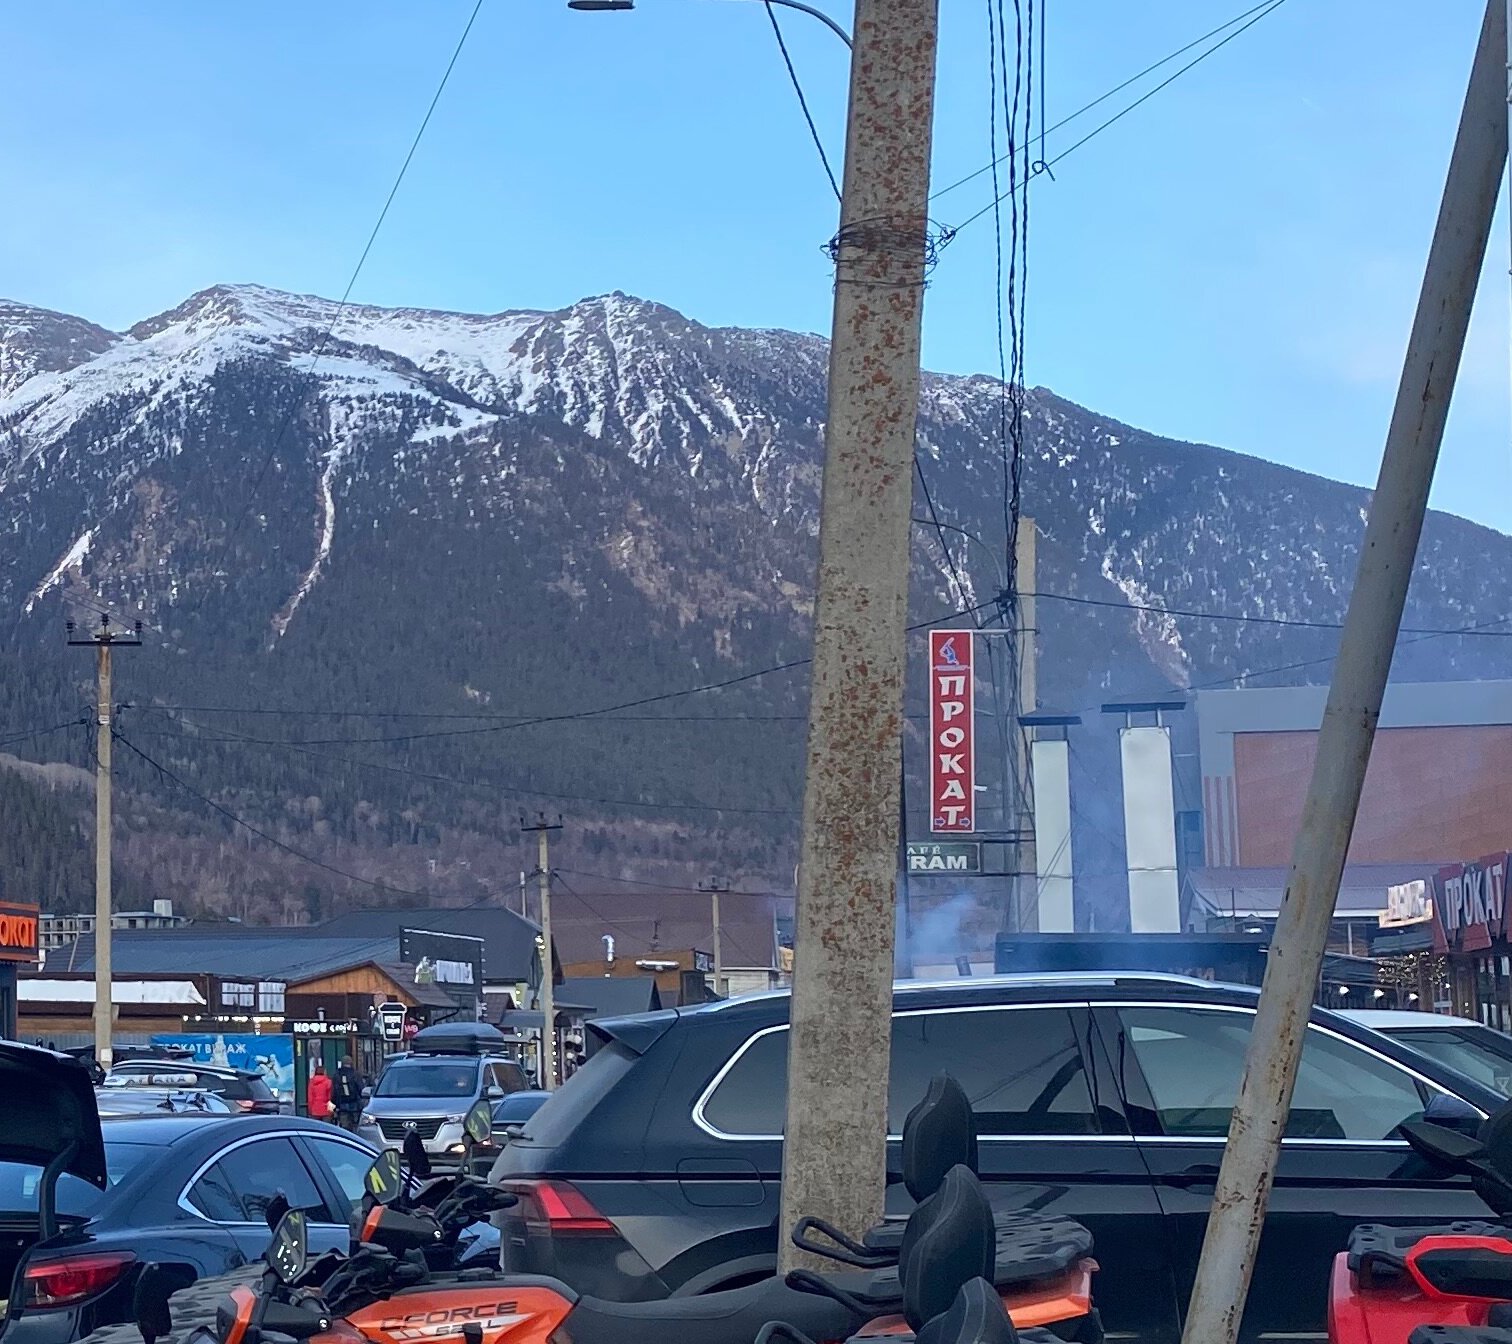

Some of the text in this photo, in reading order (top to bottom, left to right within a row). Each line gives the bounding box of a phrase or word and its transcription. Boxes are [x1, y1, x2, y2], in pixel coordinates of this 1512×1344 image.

[938, 675, 966, 826] ПРОКАТ
[907, 855, 968, 869] RAM
[1445, 863, 1503, 931] ПРОКАТ
[381, 1301, 519, 1331] CFORCE
